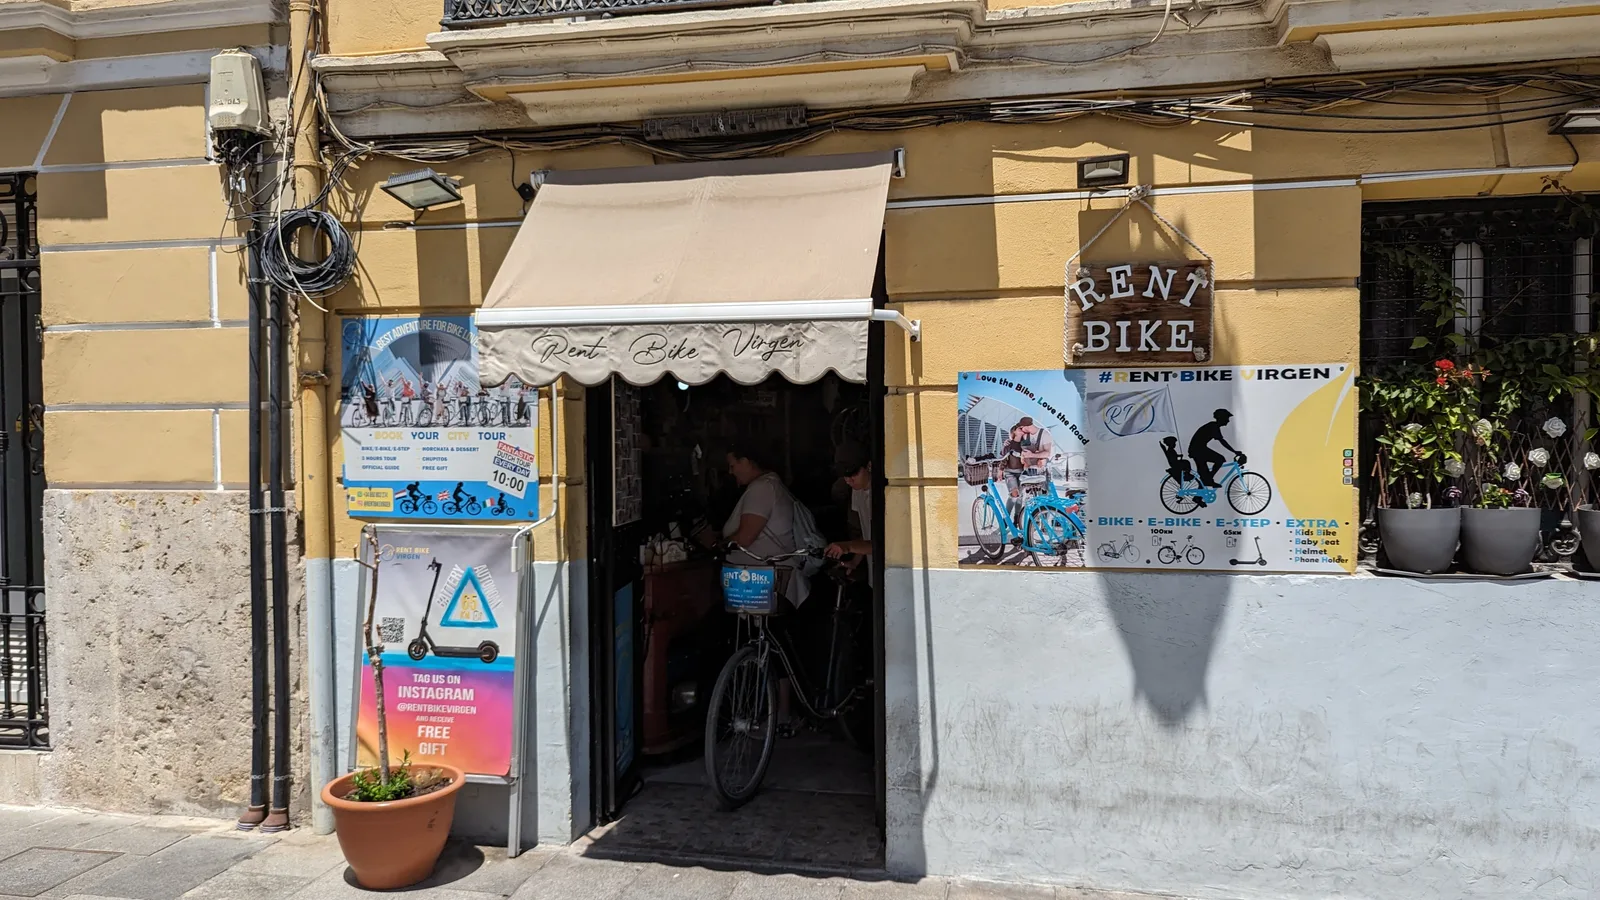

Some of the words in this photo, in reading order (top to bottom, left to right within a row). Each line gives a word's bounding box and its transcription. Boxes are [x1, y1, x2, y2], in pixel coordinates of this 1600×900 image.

[1069, 265, 1209, 312] RENT
[375, 331, 393, 350] BEST
[392, 320, 432, 340] ADVENTURE
[432, 320, 447, 331] FOR
[447, 322, 463, 337] BIKE
[1083, 320, 1194, 352] BIKE
[531, 334, 607, 365] Rent
[628, 333, 699, 365] Bike
[722, 323, 804, 361] Virgen
[1099, 370, 1173, 383] #RENT
[1180, 370, 1233, 382] BIKE
[1240, 368, 1330, 381] VIRGEN
[975, 372, 997, 384] Love
[999, 376, 1014, 389] the
[1015, 383, 1036, 401] Bike,
[1037, 396, 1057, 415] Love
[1056, 412, 1070, 427] the
[1069, 424, 1090, 446] Road
[374, 431, 404, 440] BOOK
[411, 431, 439, 440] YOUR
[447, 431, 470, 440] CITY
[478, 432, 506, 440] TOUR
[496, 450, 516, 462] DUTCH
[516, 457, 531, 468] TOUR
[498, 442, 535, 463] FANTASTIC
[494, 458, 516, 471] EVERY
[516, 467, 531, 477] DAY
[493, 470, 524, 492] 10:00
[1098, 517, 1134, 526] BIKE
[1147, 518, 1201, 527] E-BIKE
[1215, 518, 1271, 527] E-STEP
[1285, 519, 1339, 528] EXTRA
[1295, 538, 1318, 546] Baby
[1321, 538, 1340, 546] Seat
[1295, 547, 1328, 555] Helmet
[1321, 556, 1349, 564] Holder
[751, 572, 768, 582] BIKE
[412, 673, 431, 683] TAG
[432, 674, 445, 684] US
[447, 675, 461, 684] ON
[398, 686, 475, 701] INSTAGRAM
[397, 703, 477, 715] @RENTBIKEVIRGEN
[417, 725, 451, 739] FREE
[419, 742, 448, 756] GIFT
